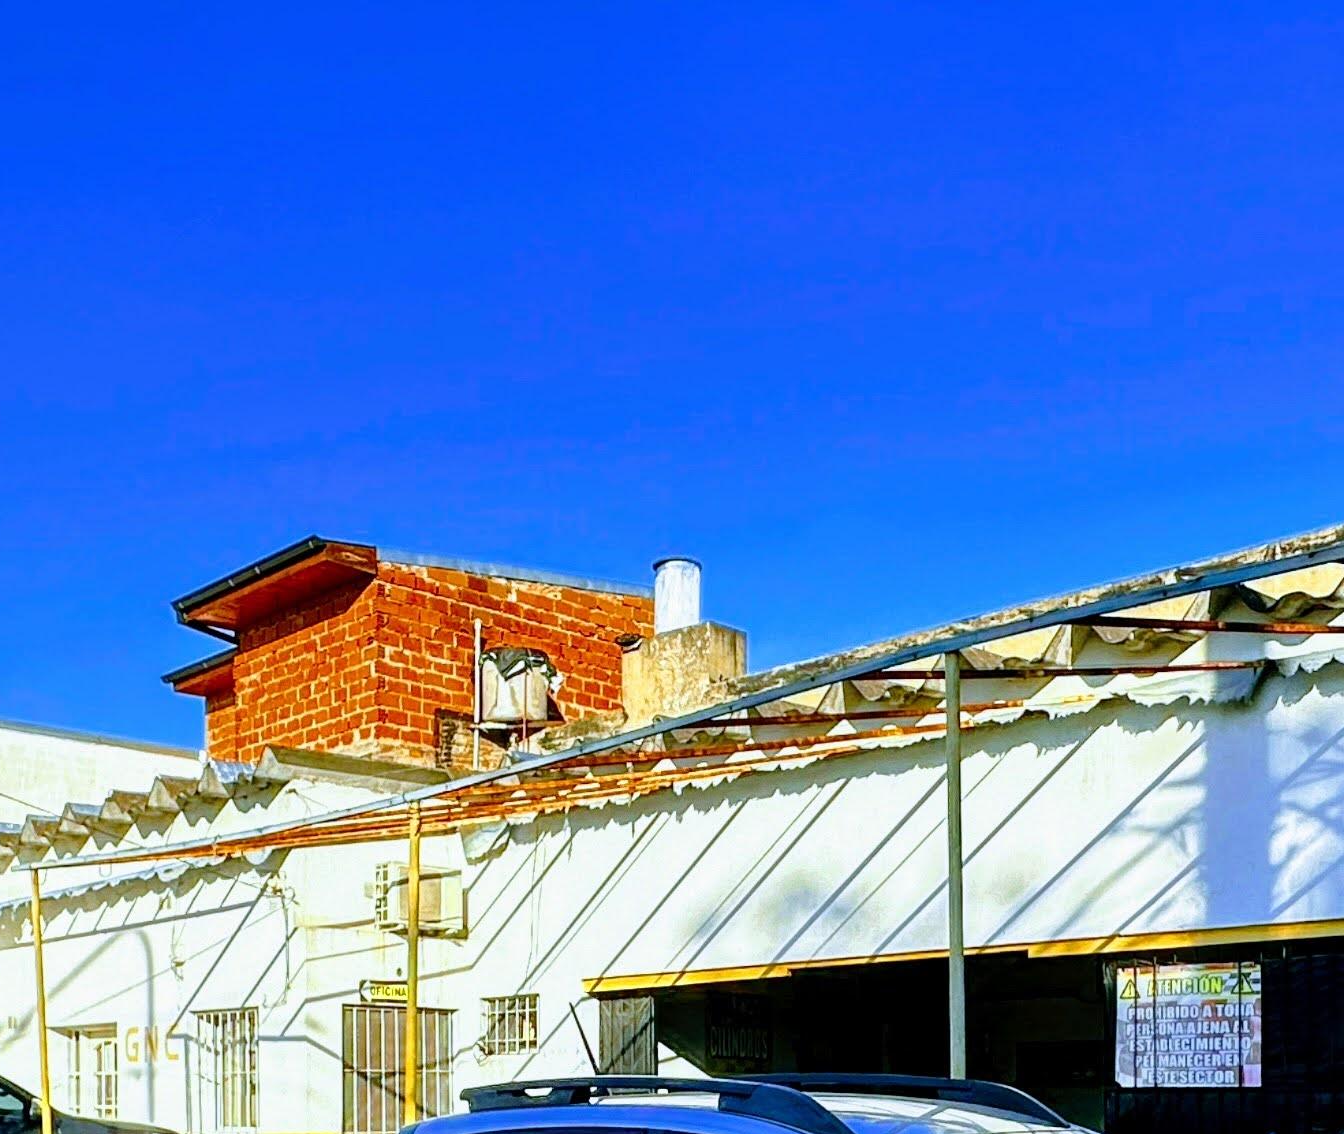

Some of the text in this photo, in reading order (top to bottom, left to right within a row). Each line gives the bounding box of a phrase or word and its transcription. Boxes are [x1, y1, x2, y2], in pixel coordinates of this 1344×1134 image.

[369, 986, 407, 997] OFICINA
[1147, 975, 1223, 997] ATENCIÓN
[1128, 1005, 1199, 1020] PROHIBIDO
[1203, 1004, 1212, 1017] A
[1186, 1020, 1230, 1034] AJENA
[125, 1023, 179, 1063] GNC
[1179, 1070, 1235, 1083] SECTOR
